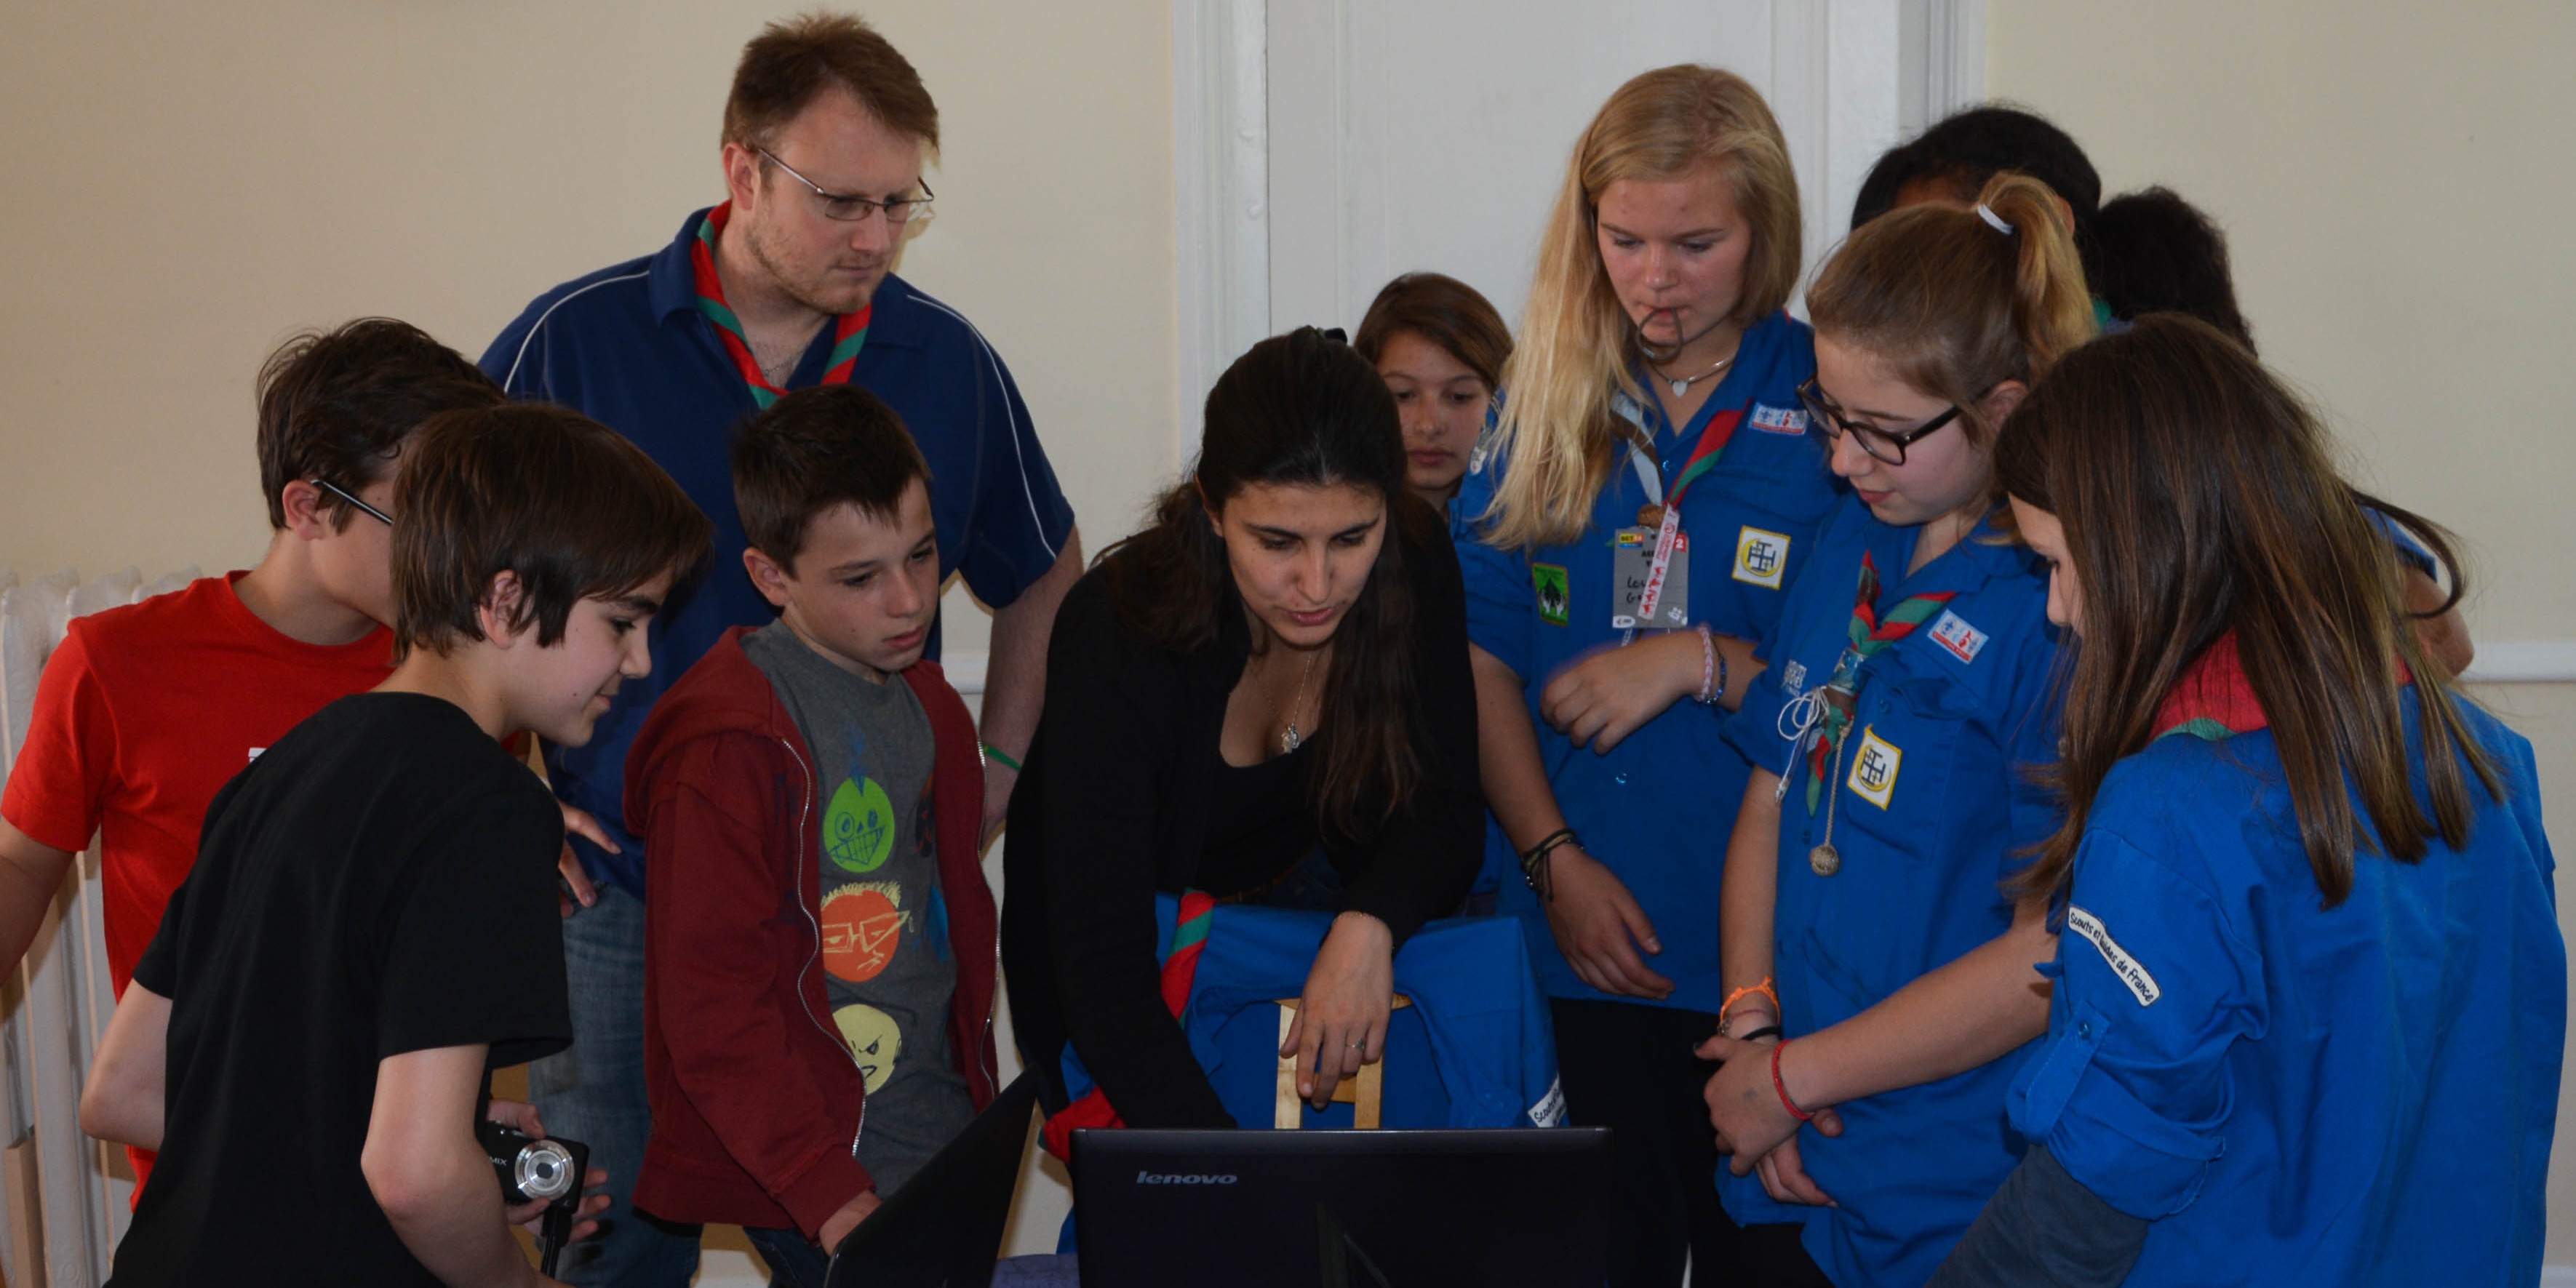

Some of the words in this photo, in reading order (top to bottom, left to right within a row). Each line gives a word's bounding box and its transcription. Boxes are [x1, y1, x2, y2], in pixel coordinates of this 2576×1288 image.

[1675, 538, 1683, 548] 2
[2070, 913, 2094, 934] Scouts
[2116, 960, 2128, 973] de
[2127, 969, 2154, 1001] France
[489, 1156, 507, 1166] MIX
[1136, 1171, 1237, 1184] lenovo
